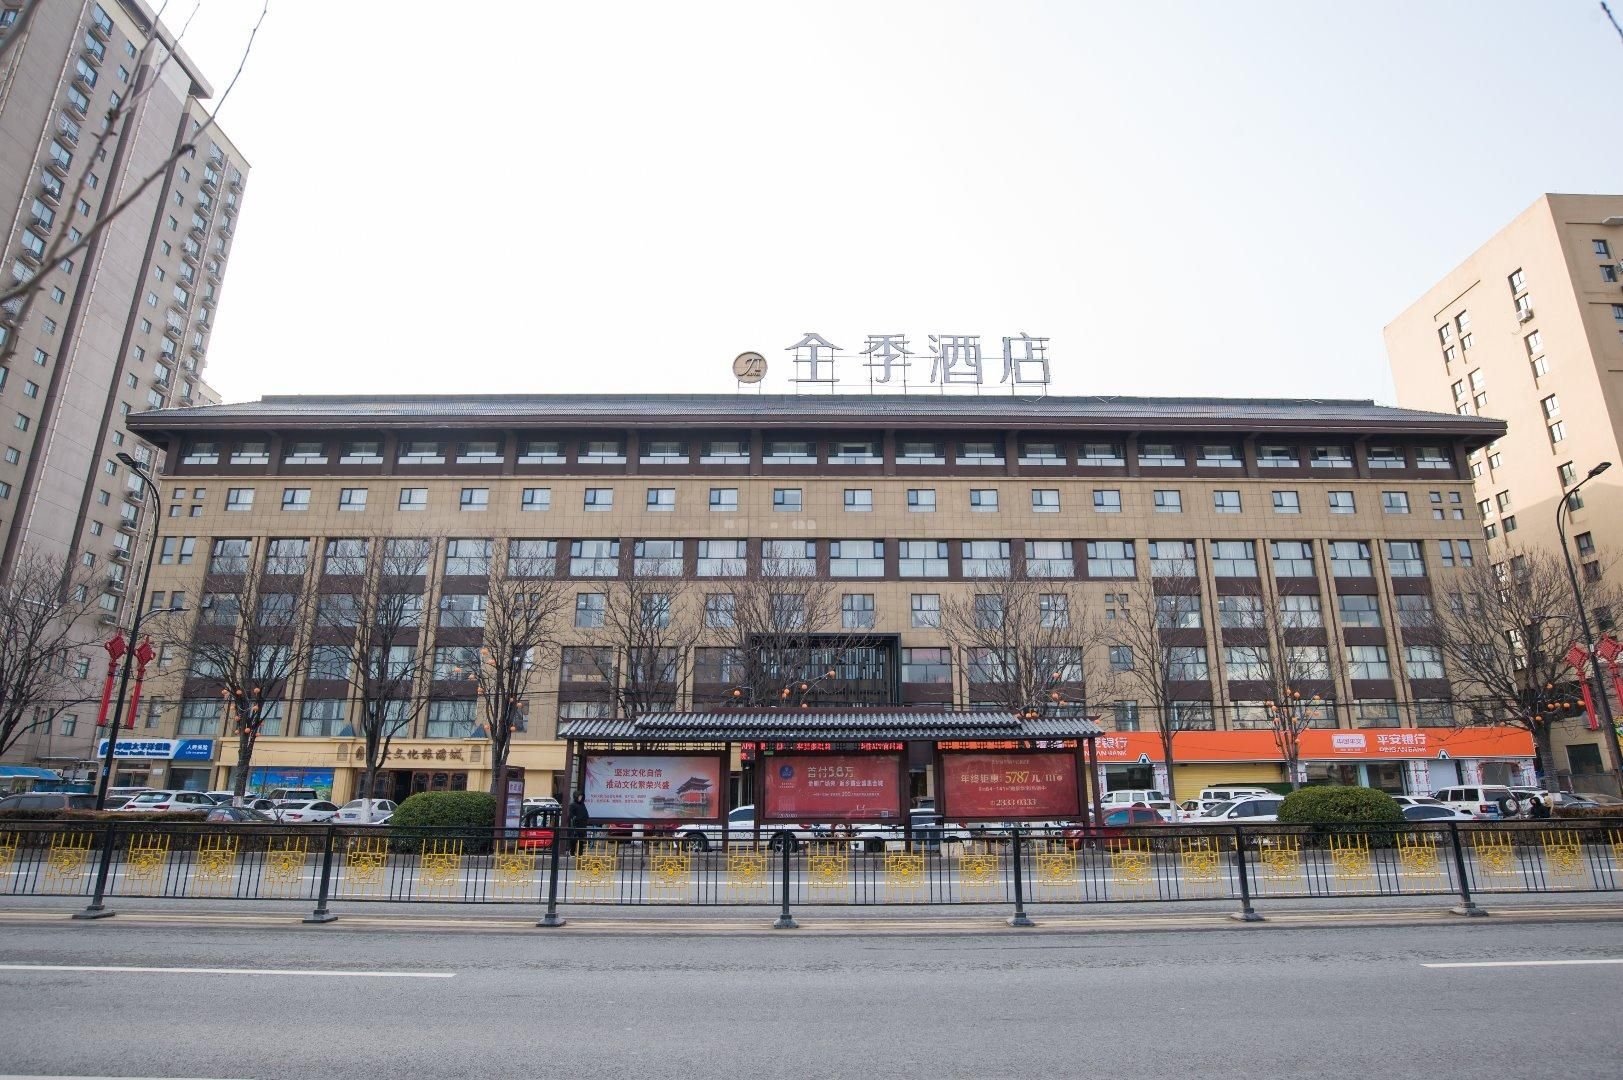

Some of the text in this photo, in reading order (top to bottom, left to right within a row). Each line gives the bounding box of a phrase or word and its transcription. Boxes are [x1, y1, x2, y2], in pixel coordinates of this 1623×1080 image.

[785, 332, 1051, 385] 全季酒店
[1377, 733, 1427, 745] 平安银行
[614, 768, 662, 778] 坚定文化自信
[606, 779, 670, 790] 推动文化繁荣兴盛
